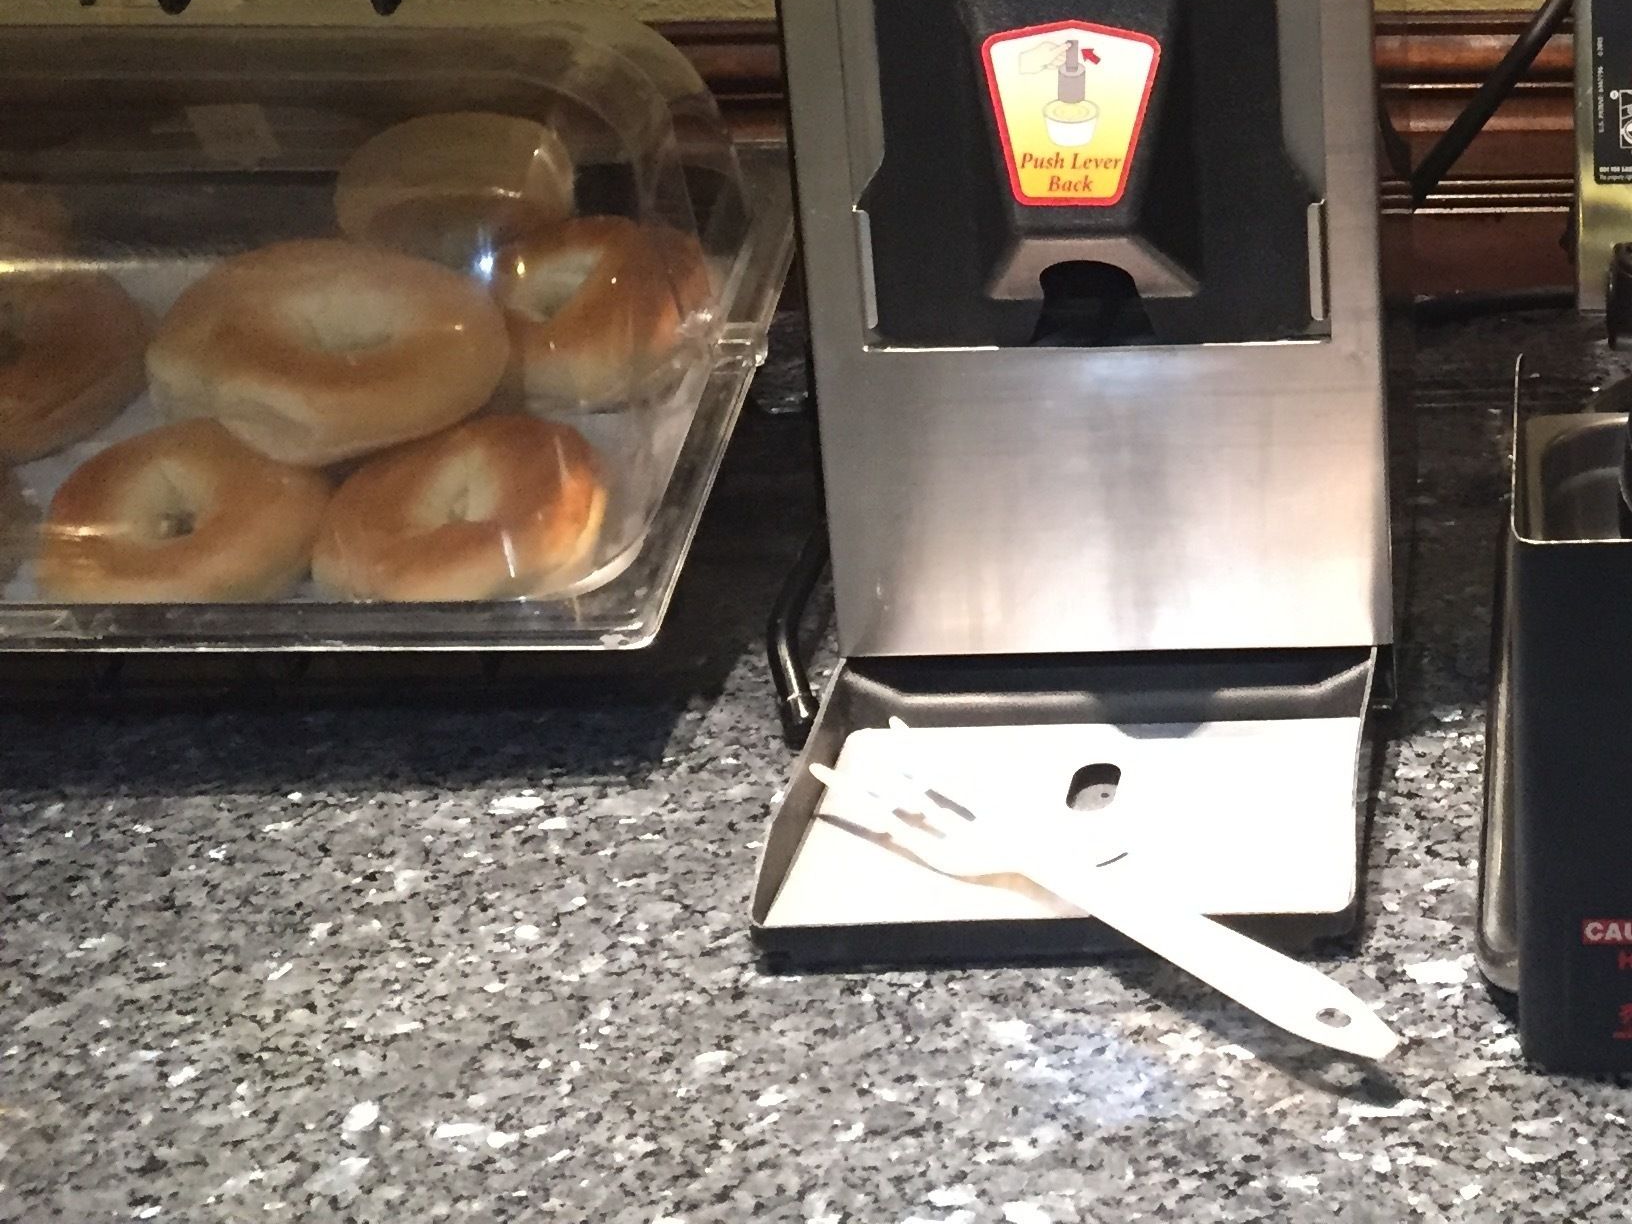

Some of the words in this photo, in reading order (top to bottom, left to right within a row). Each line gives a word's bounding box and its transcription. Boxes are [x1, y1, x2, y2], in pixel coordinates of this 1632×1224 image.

[1020, 151, 1065, 170] Push
[1069, 151, 1122, 170] Lever
[1047, 174, 1094, 192] Back
